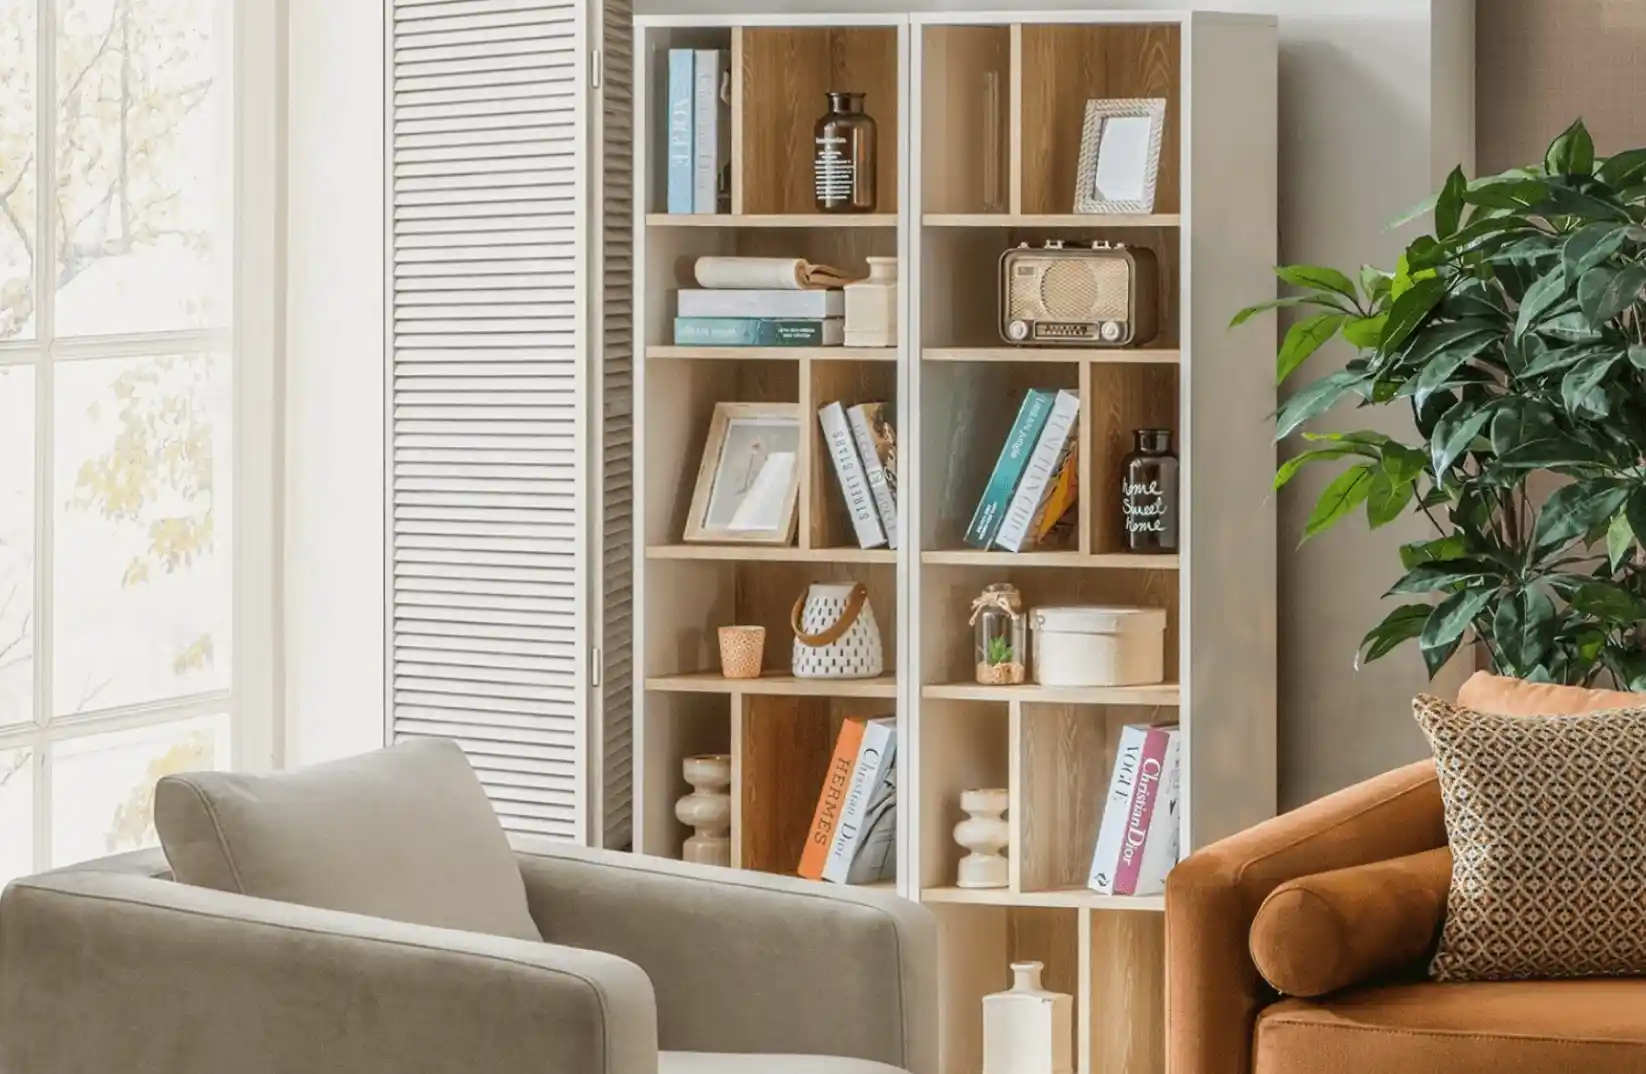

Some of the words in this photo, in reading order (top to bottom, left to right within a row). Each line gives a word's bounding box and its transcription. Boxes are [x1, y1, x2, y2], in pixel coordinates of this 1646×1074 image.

[671, 98, 689, 167] VOGUE
[845, 474, 870, 521] STREET
[847, 747, 880, 816] Christian
[1113, 745, 1140, 804] VOGUE
[833, 822, 857, 858] Dior
